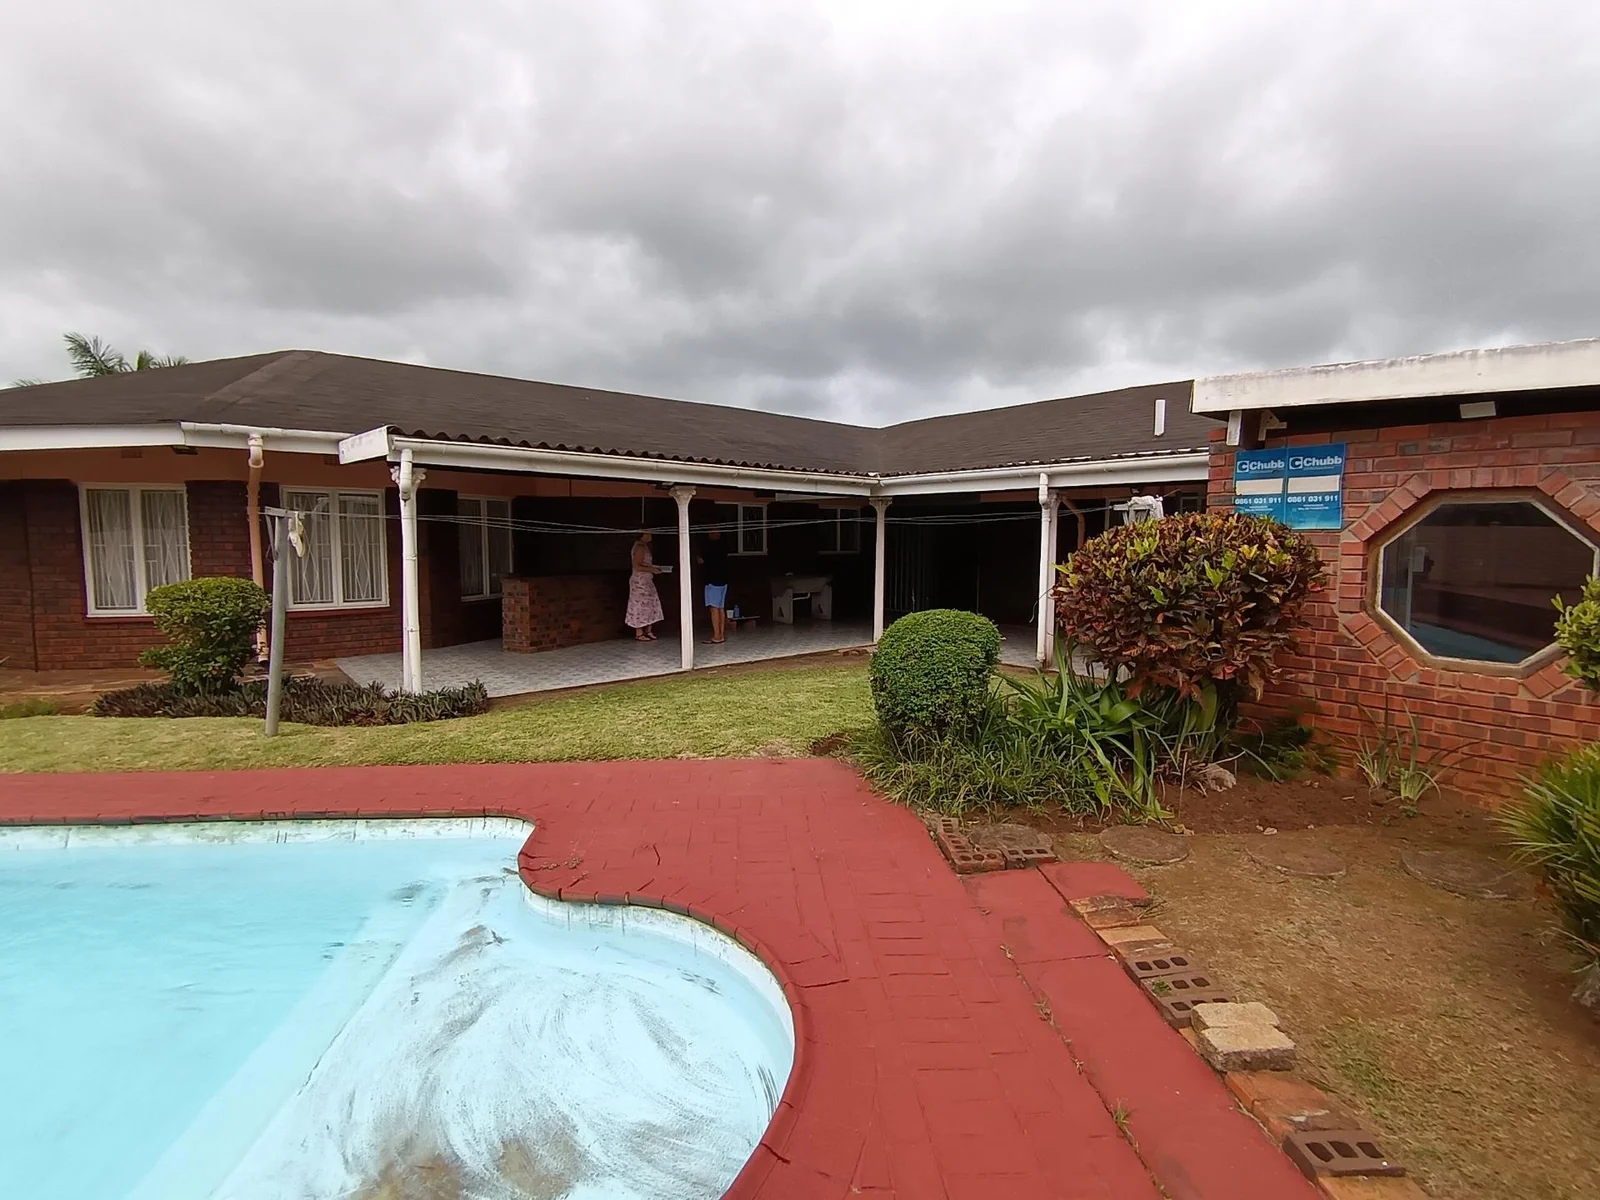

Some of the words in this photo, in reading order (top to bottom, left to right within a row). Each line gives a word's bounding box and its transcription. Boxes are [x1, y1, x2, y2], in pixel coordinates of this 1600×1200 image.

[1249, 459, 1285, 471] Chubb
[1303, 455, 1342, 467] Chubb
[1308, 495, 1322, 503] 031
[1324, 494, 1338, 502] 911
